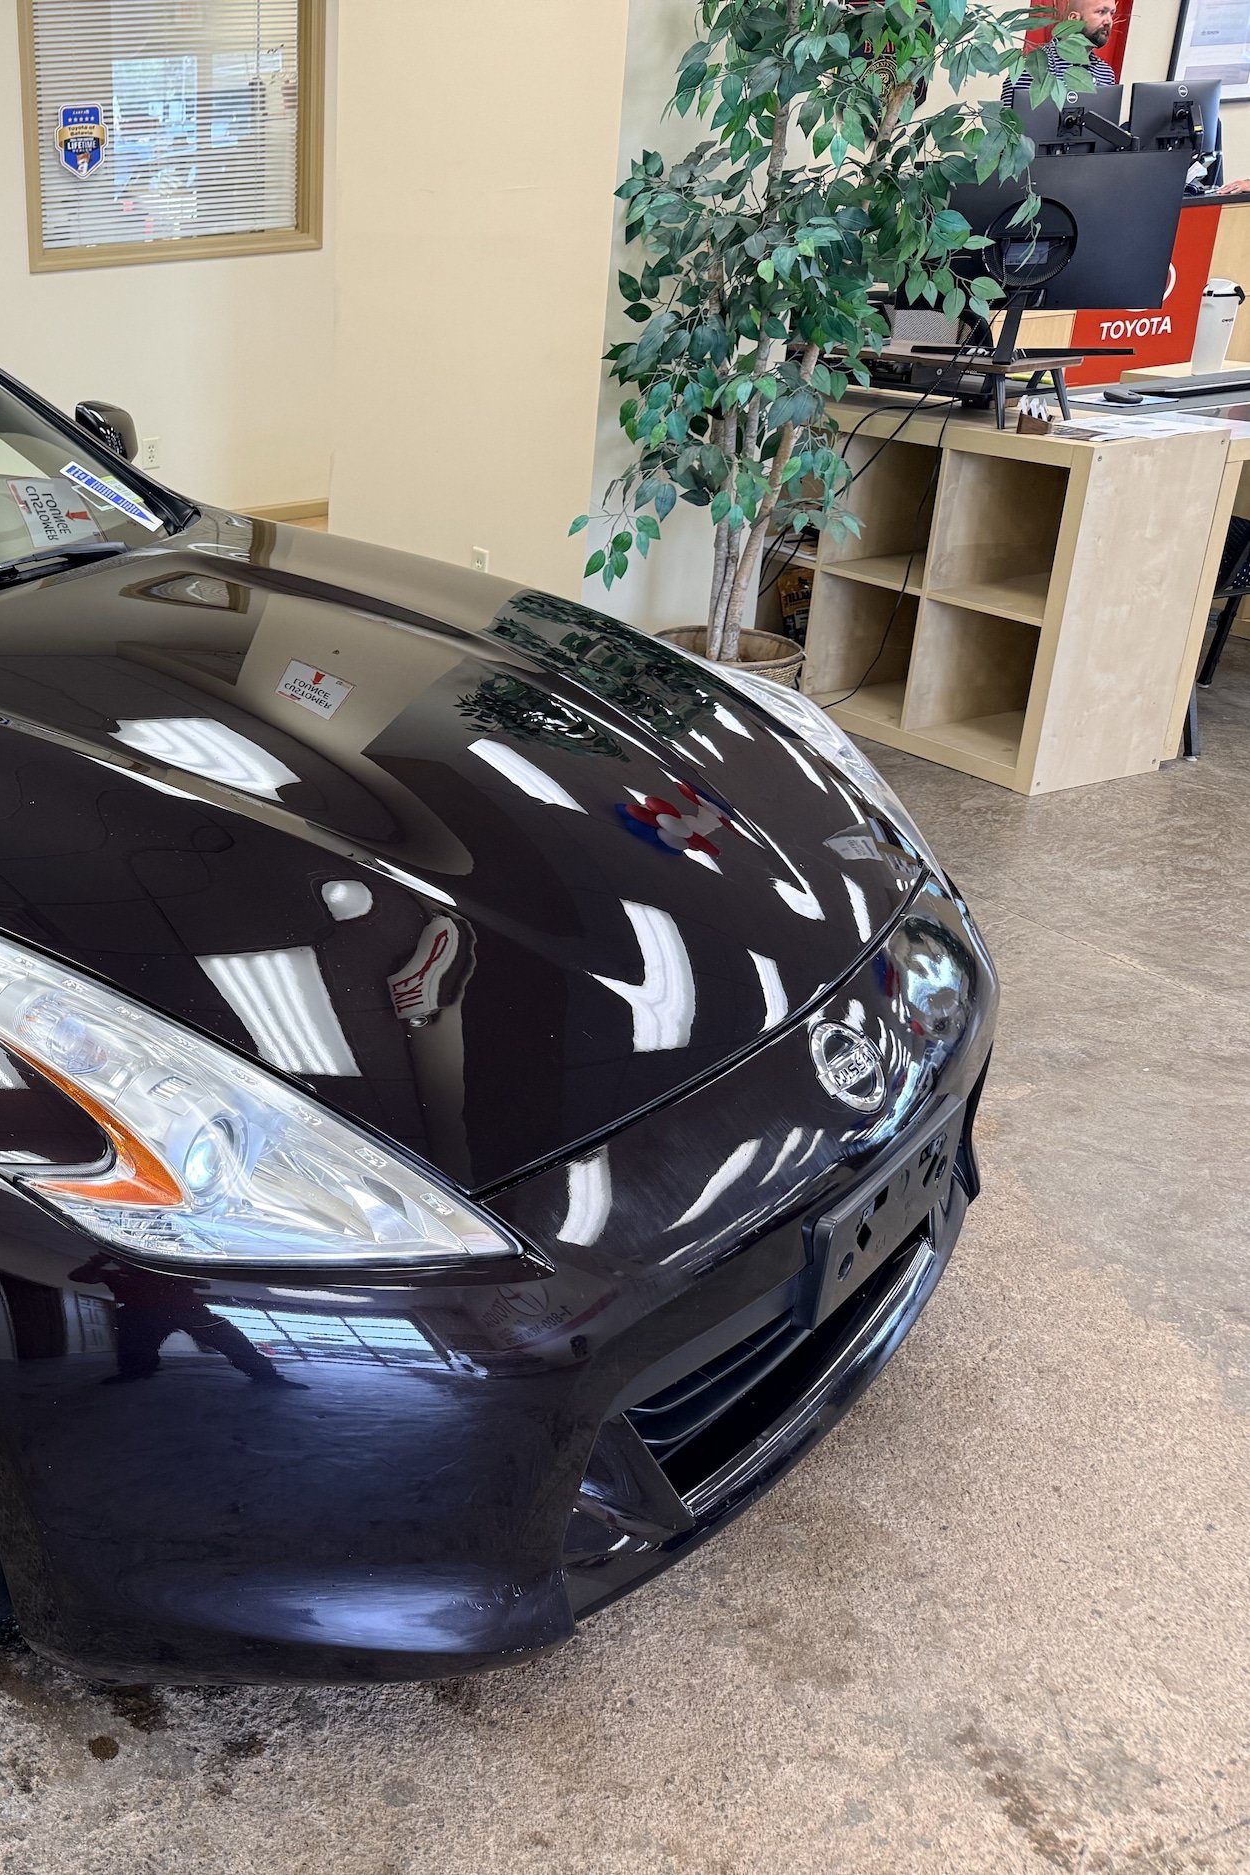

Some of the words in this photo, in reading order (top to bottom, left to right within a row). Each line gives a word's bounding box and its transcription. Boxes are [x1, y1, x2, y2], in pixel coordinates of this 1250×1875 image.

[67, 141, 96, 150] LIFETIME
[1100, 316, 1172, 340] TOYOTA
[834, 1046, 877, 1087] NISSAN
